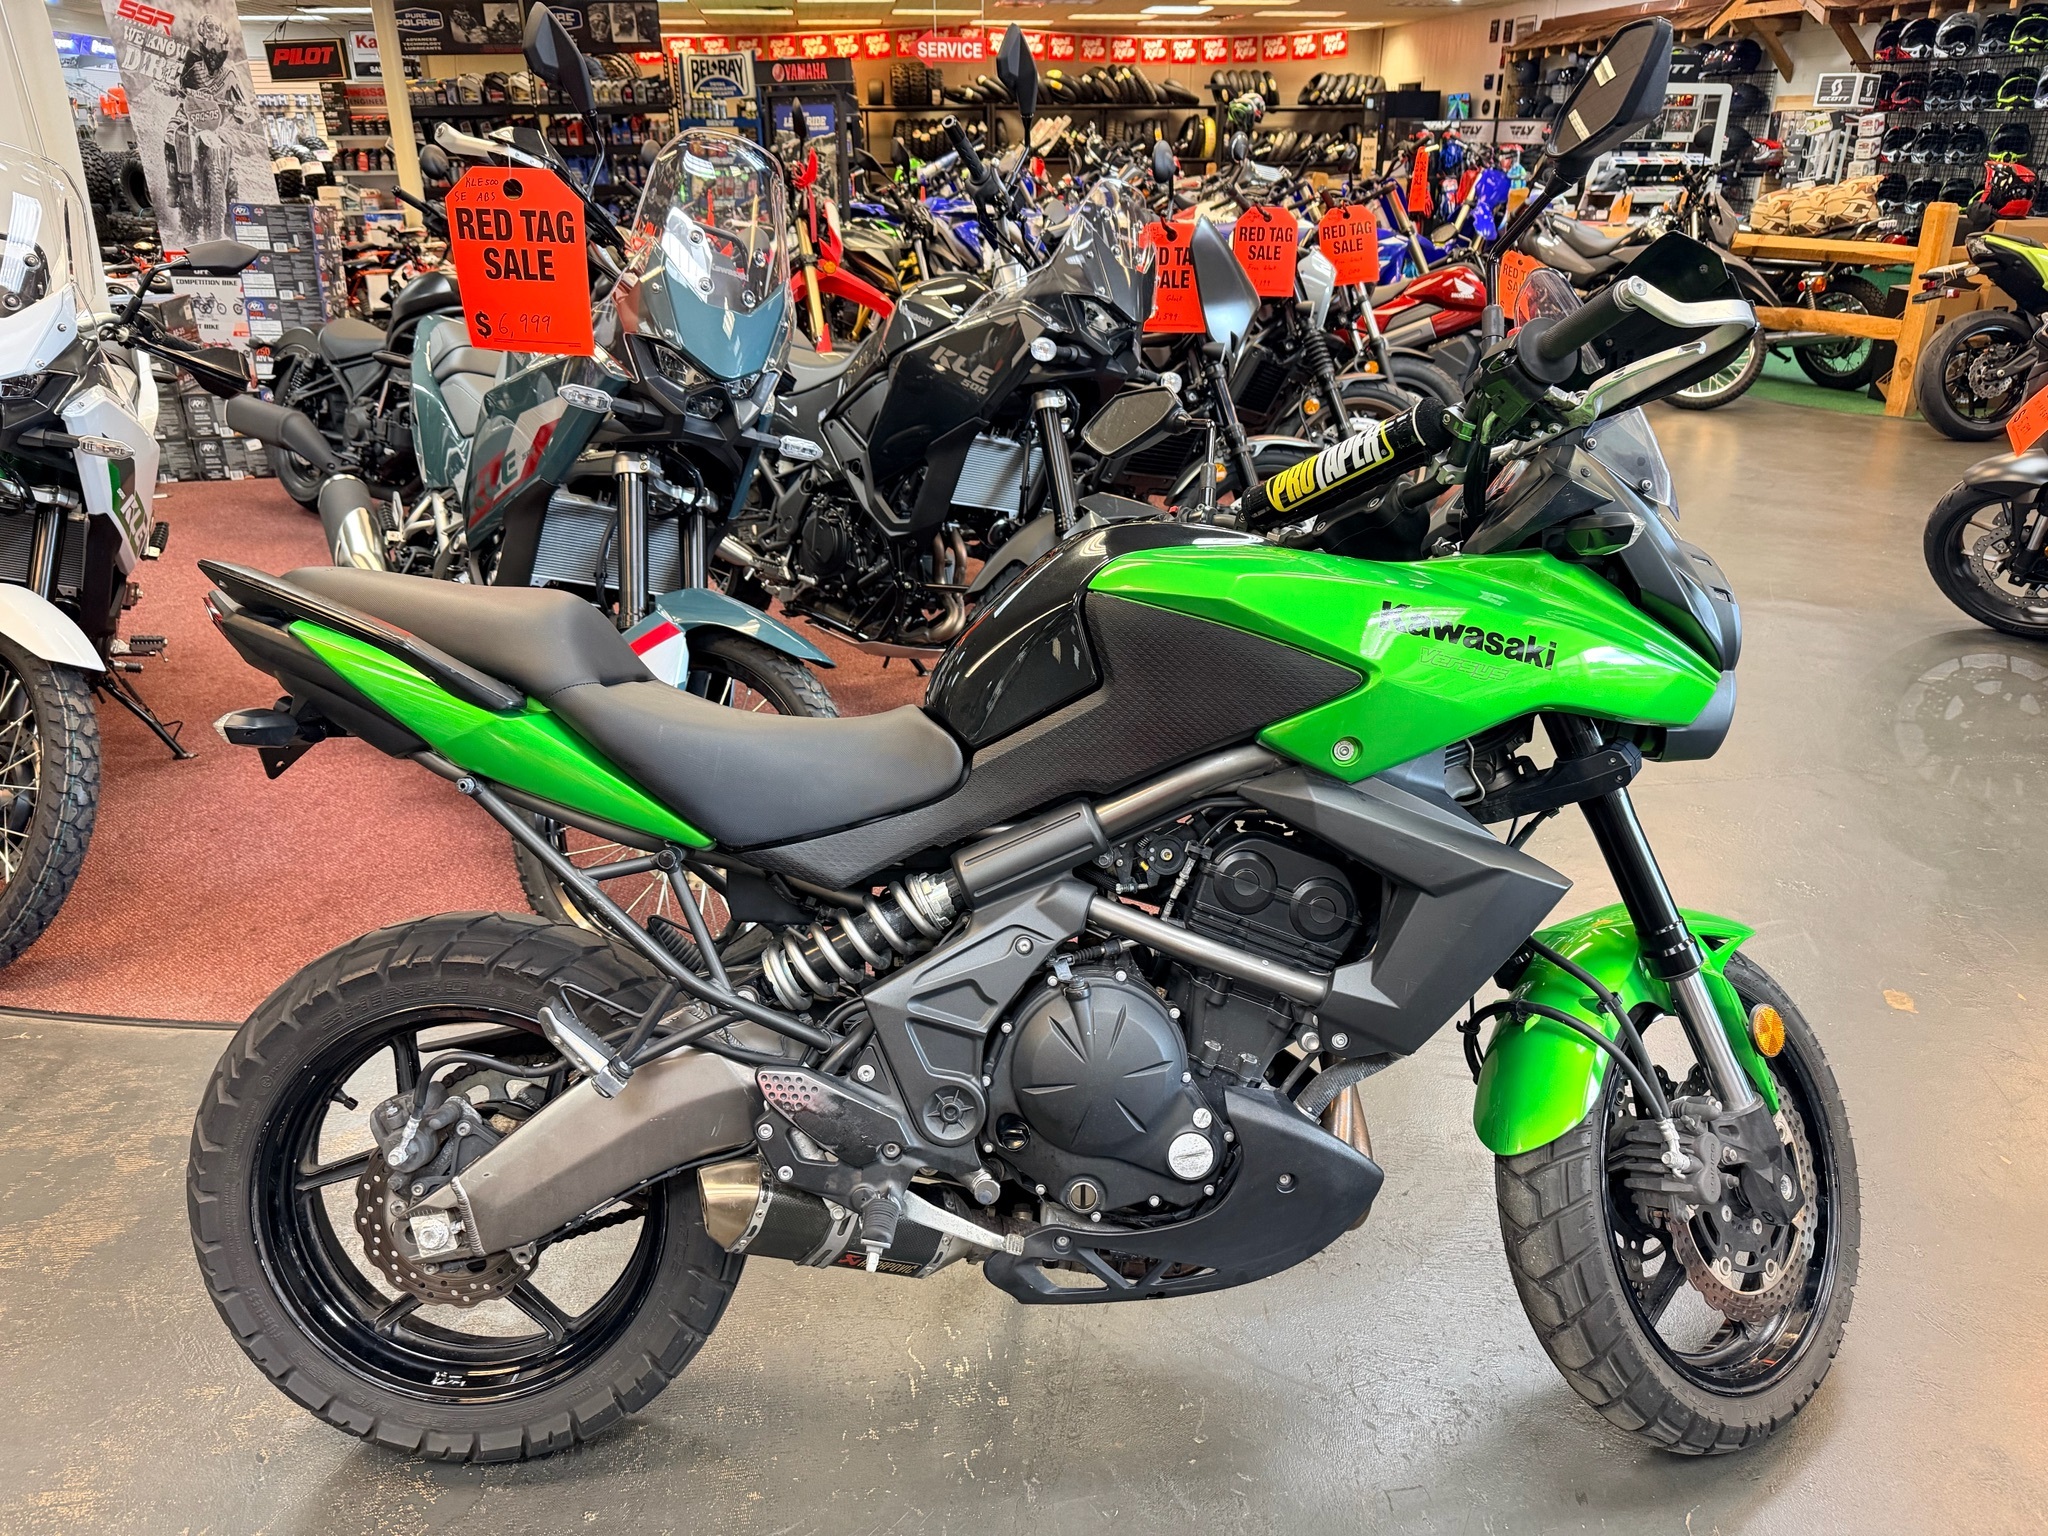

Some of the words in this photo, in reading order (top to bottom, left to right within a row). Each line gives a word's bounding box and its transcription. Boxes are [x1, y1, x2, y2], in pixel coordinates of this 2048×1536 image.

[116, 0, 175, 37] SSR
[123, 26, 145, 45] WE
[146, 34, 190, 58] KNOW
[917, 42, 982, 58] SERVICE
[122, 45, 186, 85] DIRT
[273, 46, 334, 66] PILOT
[784, 62, 828, 81] YAMAHA
[1461, 125, 1482, 135] FLY
[1509, 125, 1535, 135] FLY
[455, 191, 467, 202] SE
[476, 191, 497, 202] ABS
[455, 208, 513, 241] RED
[520, 210, 575, 243] TAG
[1239, 227, 1265, 242] RED
[1269, 227, 1293, 242] TAG
[1323, 225, 1346, 240] RED
[1349, 221, 1372, 236] TAG
[1248, 245, 1281, 260] SALE
[1333, 238, 1363, 254] SALE
[483, 247, 556, 281] SALE
[1502, 264, 1519, 279] RED
[176, 278, 220, 286] COMPETITION
[221, 279, 238, 287] BIKE
[1157, 269, 1190, 288] ALE
[475, 311, 493, 339] $
[499, 312, 551, 338] 6,999
[929, 345, 995, 387] KLE
[960, 379, 989, 396] 500
[1379, 600, 1557, 671] Kawasaki
[1418, 646, 1511, 681] Versys
[321, 979, 469, 1031] SHINKO
